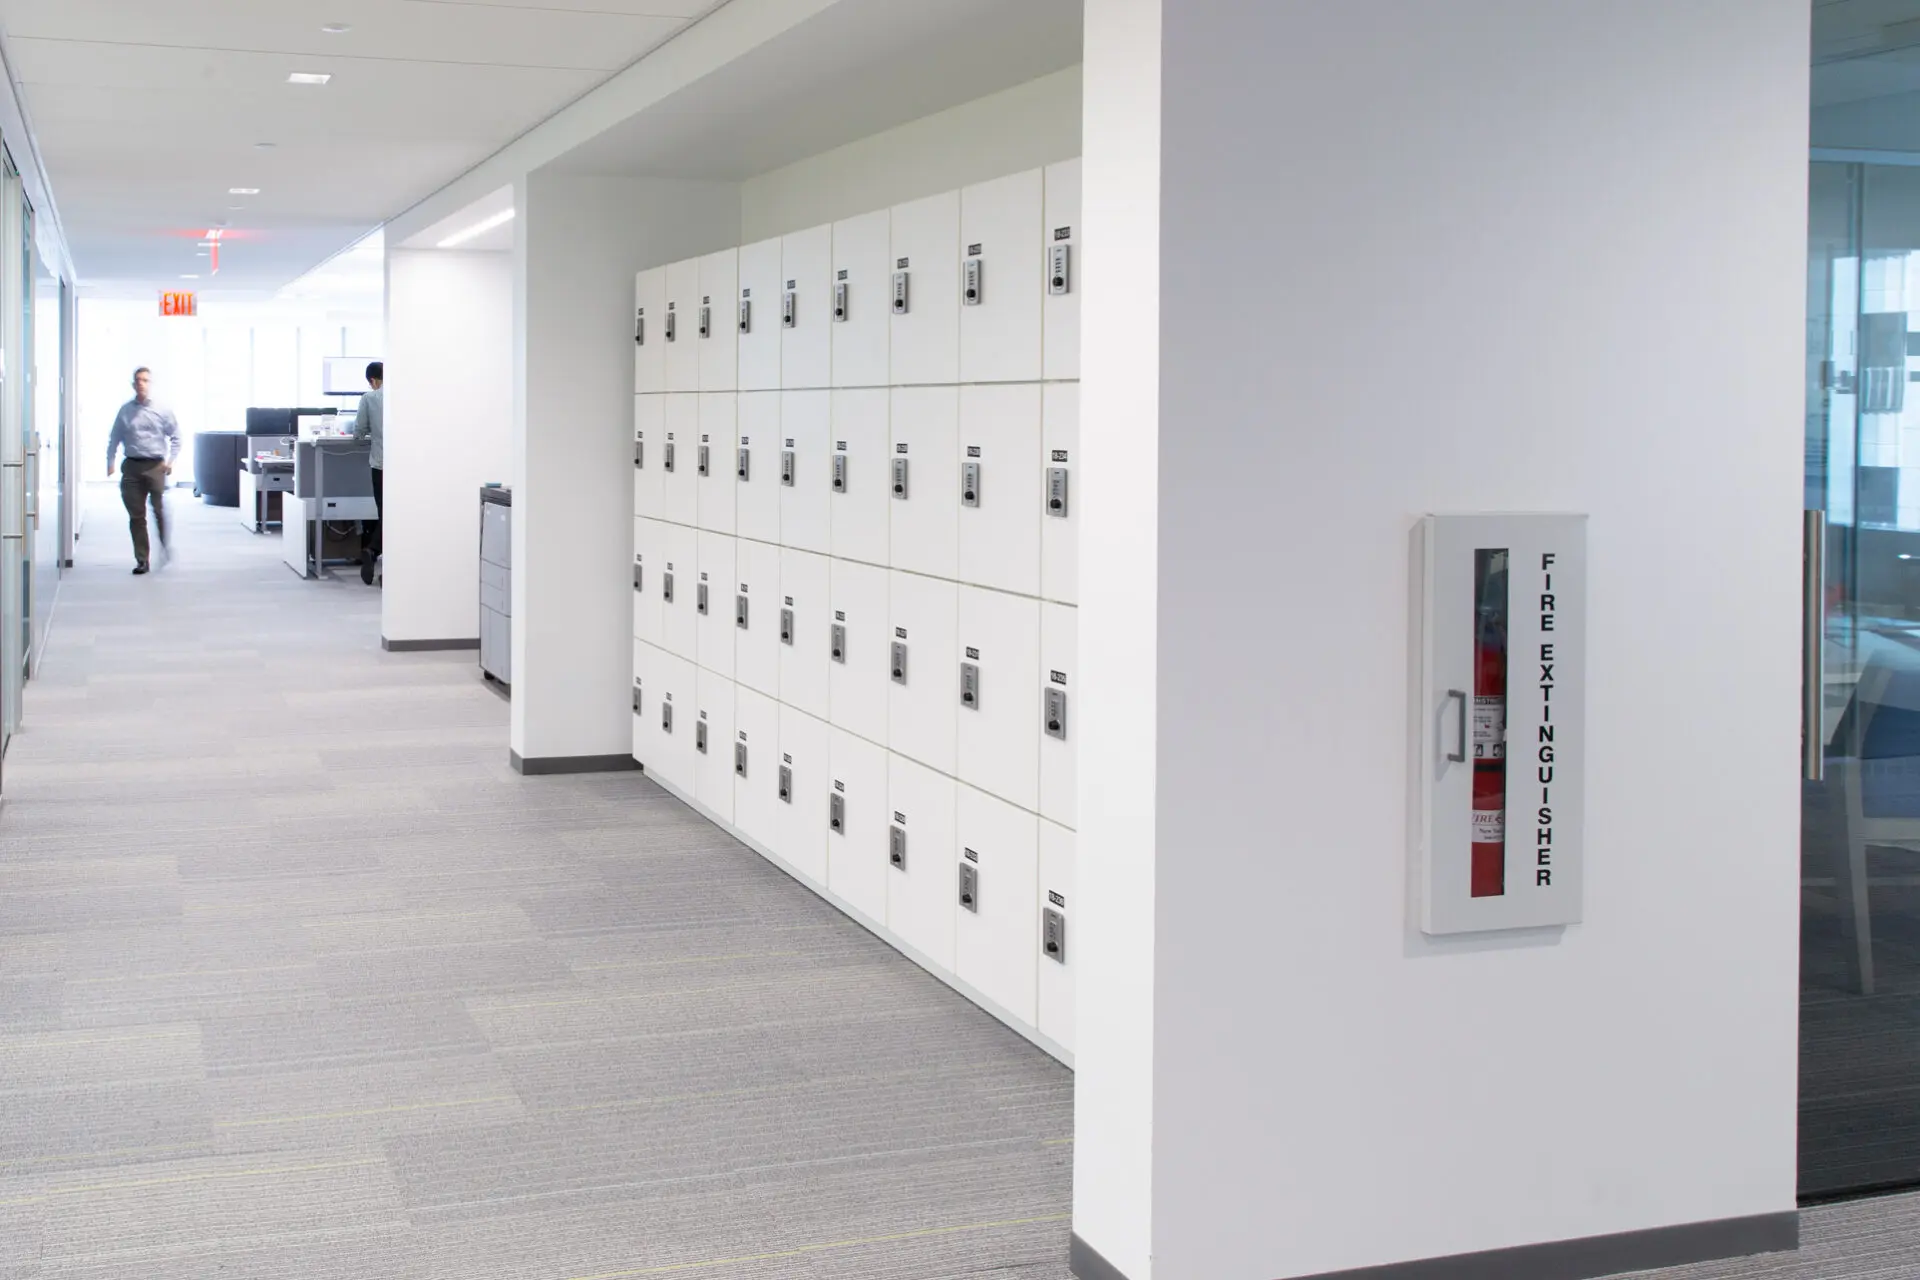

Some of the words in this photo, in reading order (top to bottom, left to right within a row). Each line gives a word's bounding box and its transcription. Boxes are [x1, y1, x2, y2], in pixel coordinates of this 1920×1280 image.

[163, 291, 193, 316] EXIT
[1540, 553, 1556, 632] FIRE
[1537, 643, 1555, 887] EXTINGUISHER
